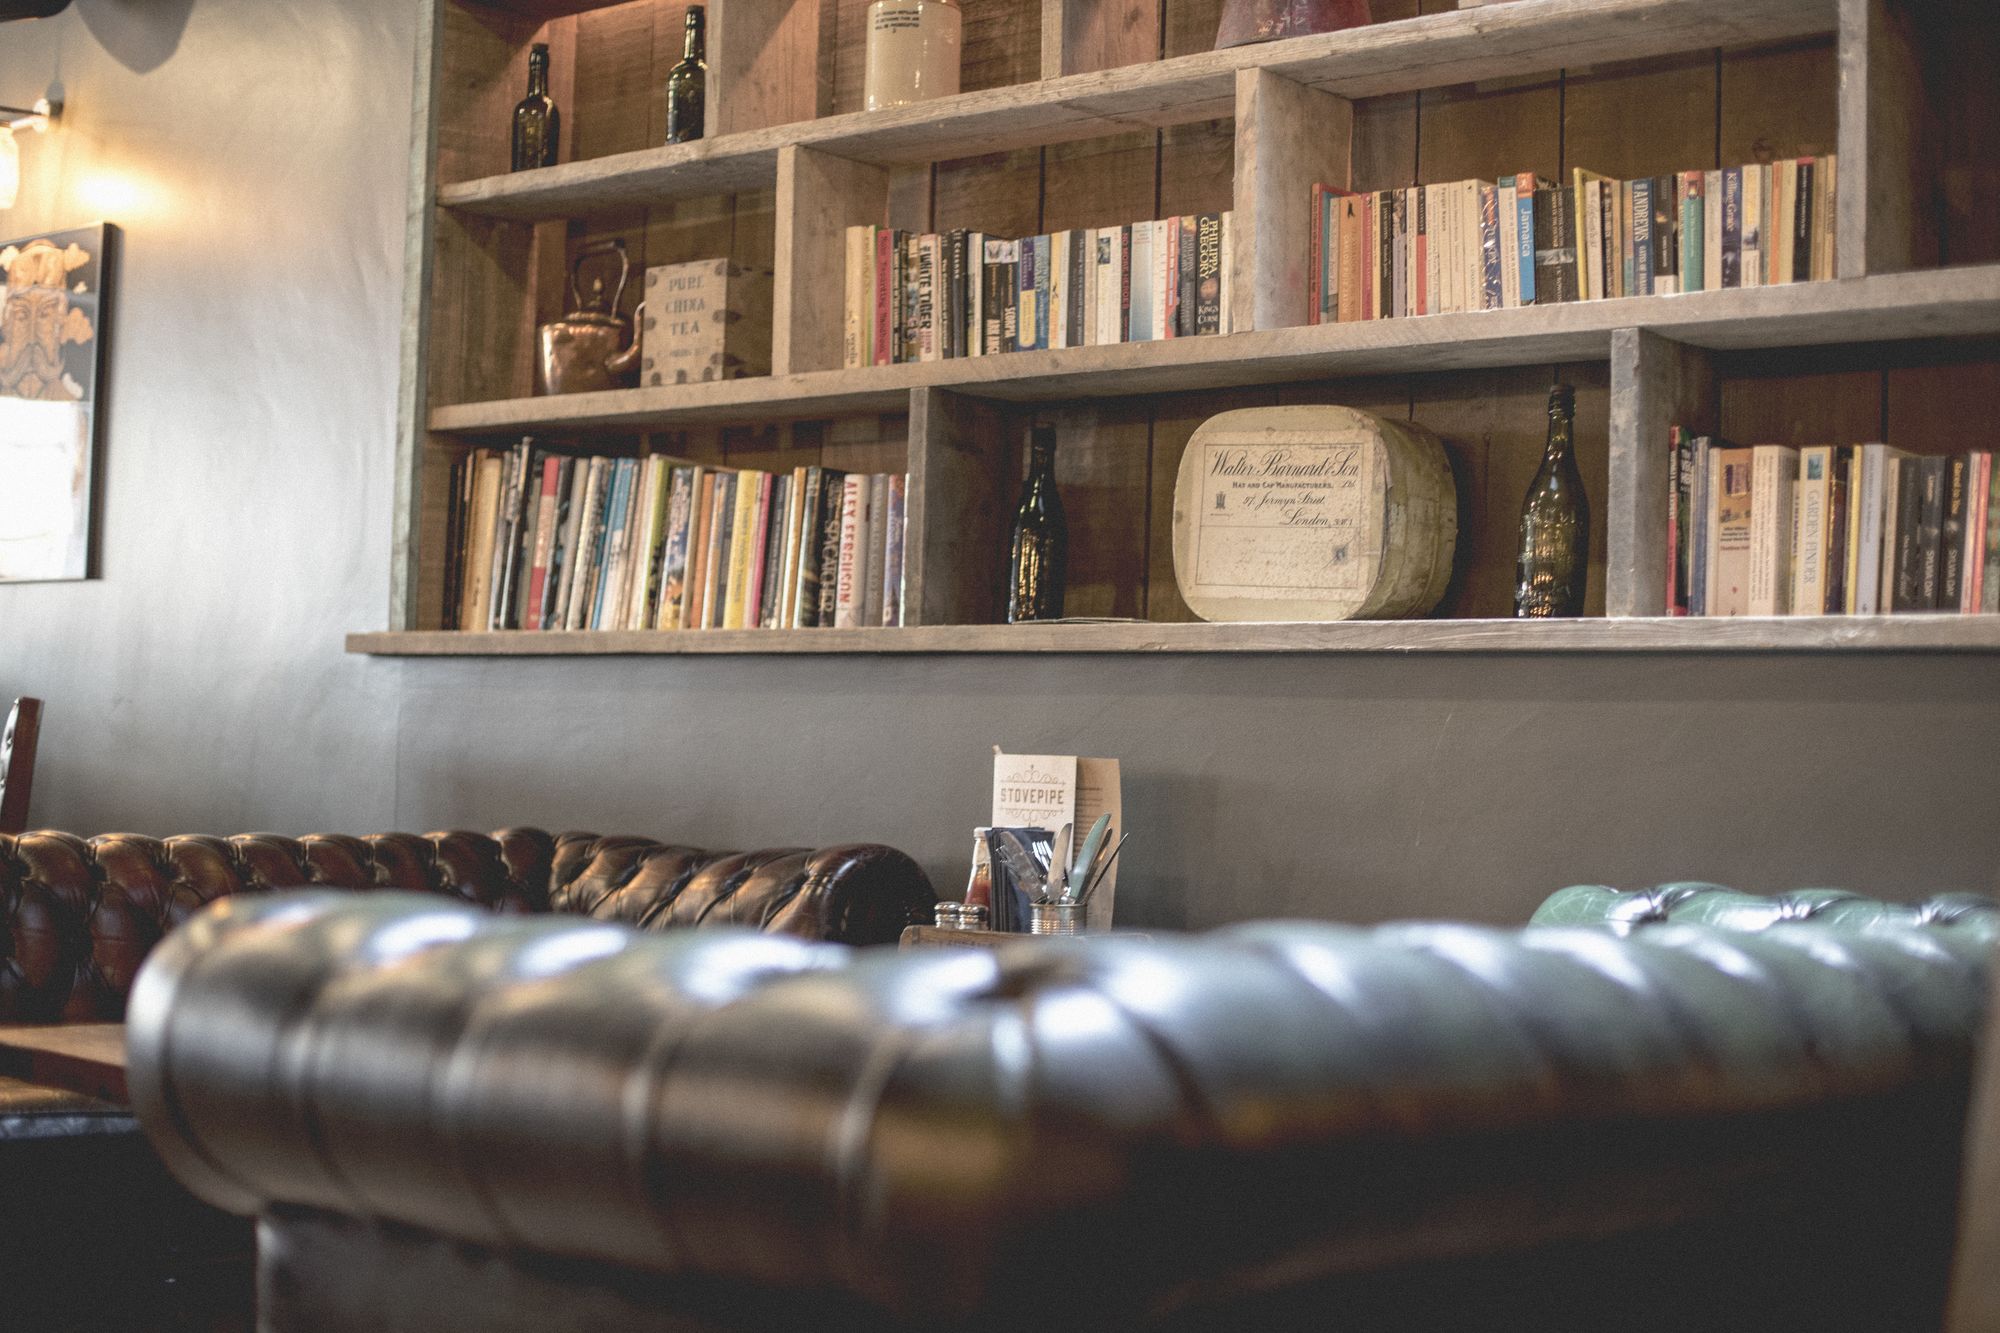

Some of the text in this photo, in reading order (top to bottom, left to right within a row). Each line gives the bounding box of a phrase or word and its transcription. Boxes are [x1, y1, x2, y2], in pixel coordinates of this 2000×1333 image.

[1521, 208, 1532, 257] Jamaica
[1633, 192, 1649, 241] ANDREWS
[920, 253, 932, 289] WHITE
[1200, 217, 1209, 279] GREGORY
[1209, 220, 1218, 274] PHILIPPA
[665, 298, 705, 314] CHINA
[669, 276, 704, 292] PURE
[671, 321, 700, 336] TEA
[920, 290, 932, 329] TIGER
[1004, 307, 1016, 338] SCORPIA
[1210, 448, 1256, 476] Walter
[1257, 448, 1329, 477] Barnard
[840, 481, 858, 604] ALEX FERGUSON
[1804, 489, 1819, 584] GARDEN FINDER
[818, 519, 839, 612] SPYCATCHER
[1924, 549, 1935, 598] SYLVIA DAY
[1947, 549, 1958, 597] SYLVIA DAY
[1000, 788, 1064, 804] STOVEPIPE
